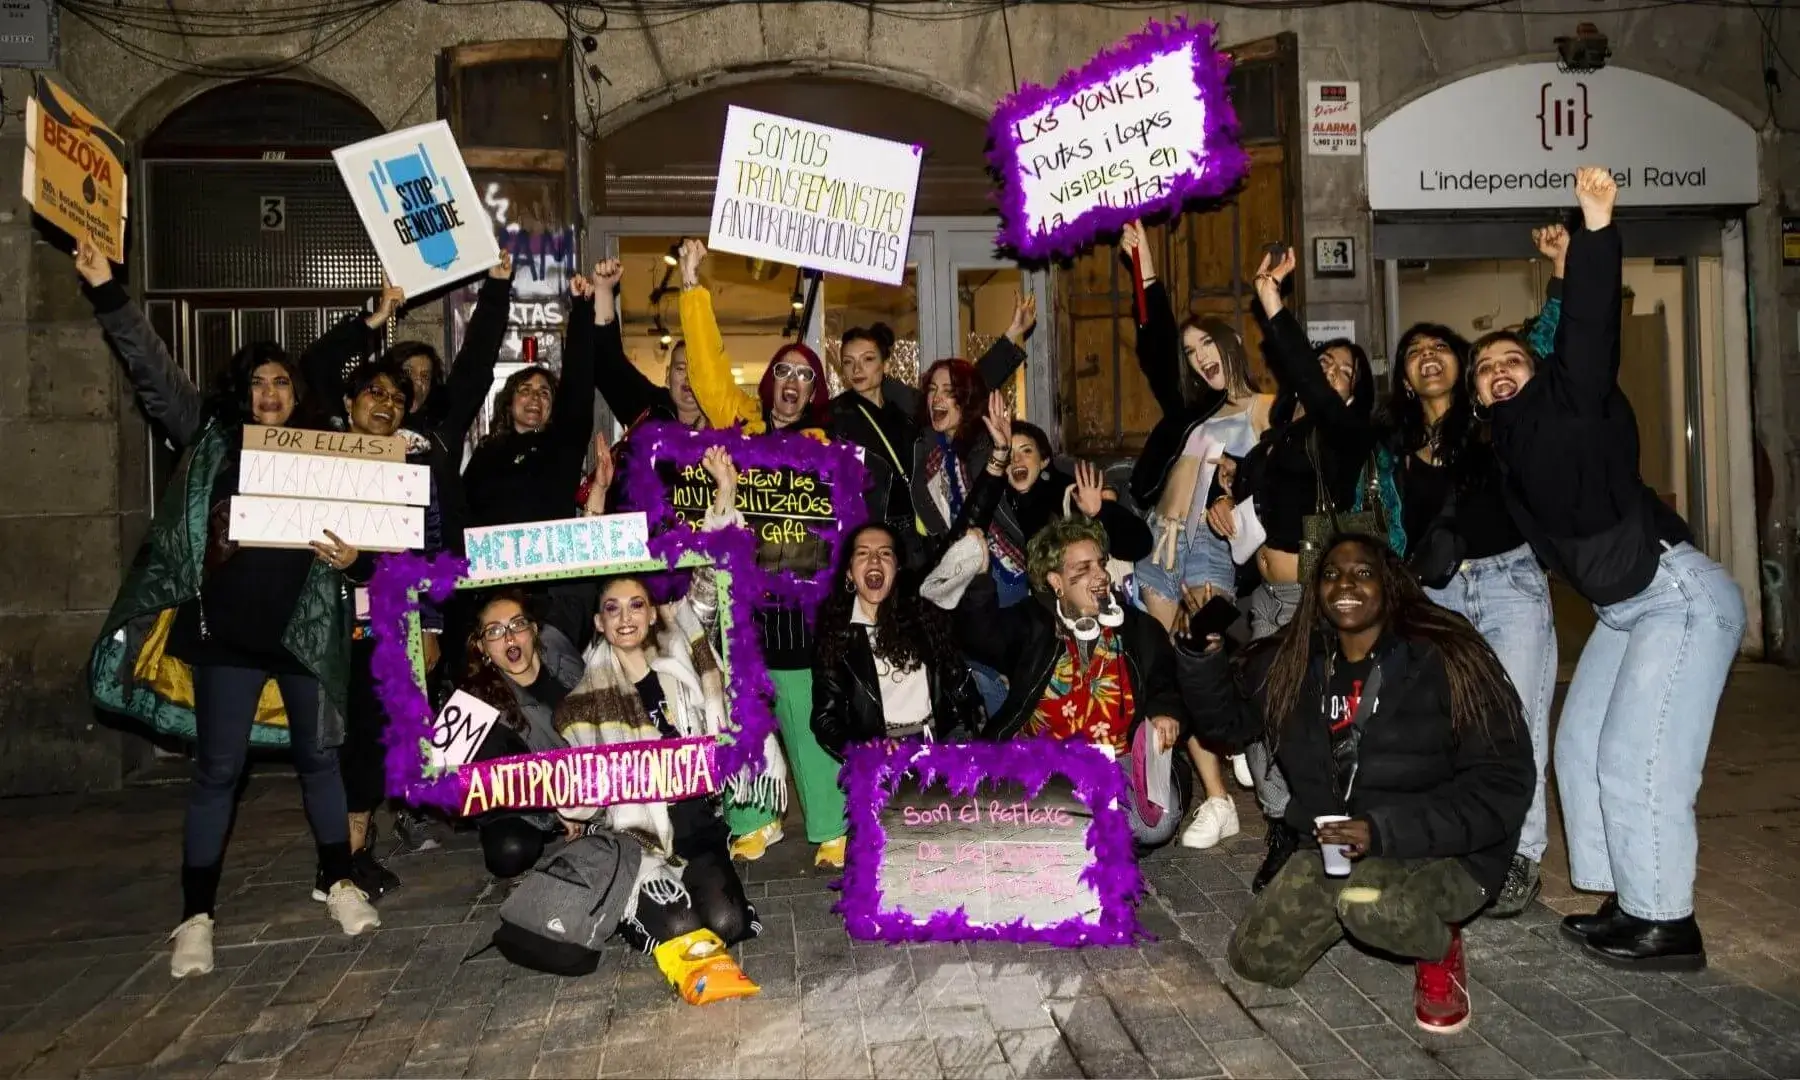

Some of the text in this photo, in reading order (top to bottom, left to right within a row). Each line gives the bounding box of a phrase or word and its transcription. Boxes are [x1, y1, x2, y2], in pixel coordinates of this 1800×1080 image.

[747, 122, 831, 168] SOMOS
[1312, 122, 1357, 133] ALARMA
[43, 113, 112, 189] BEZOYA
[1149, 145, 1178, 167] en
[395, 176, 435, 212] STOP
[735, 160, 906, 234] TRANSFEMINISTAS
[1420, 170, 1577, 194] L'independen
[1644, 166, 1707, 188] Raval
[263, 199, 283, 228] 3
[394, 199, 465, 246] GENOCIDE
[718, 198, 900, 272] ANTIPROHIBICIONISTAS
[263, 428, 393, 455] POR ELLAS:
[243, 454, 386, 498] MARINA
[260, 501, 400, 545] YARAM
[761, 519, 807, 544] CARA
[431, 705, 488, 764] 8M
[463, 742, 714, 817] ANTIPROHIBICIONISTA
